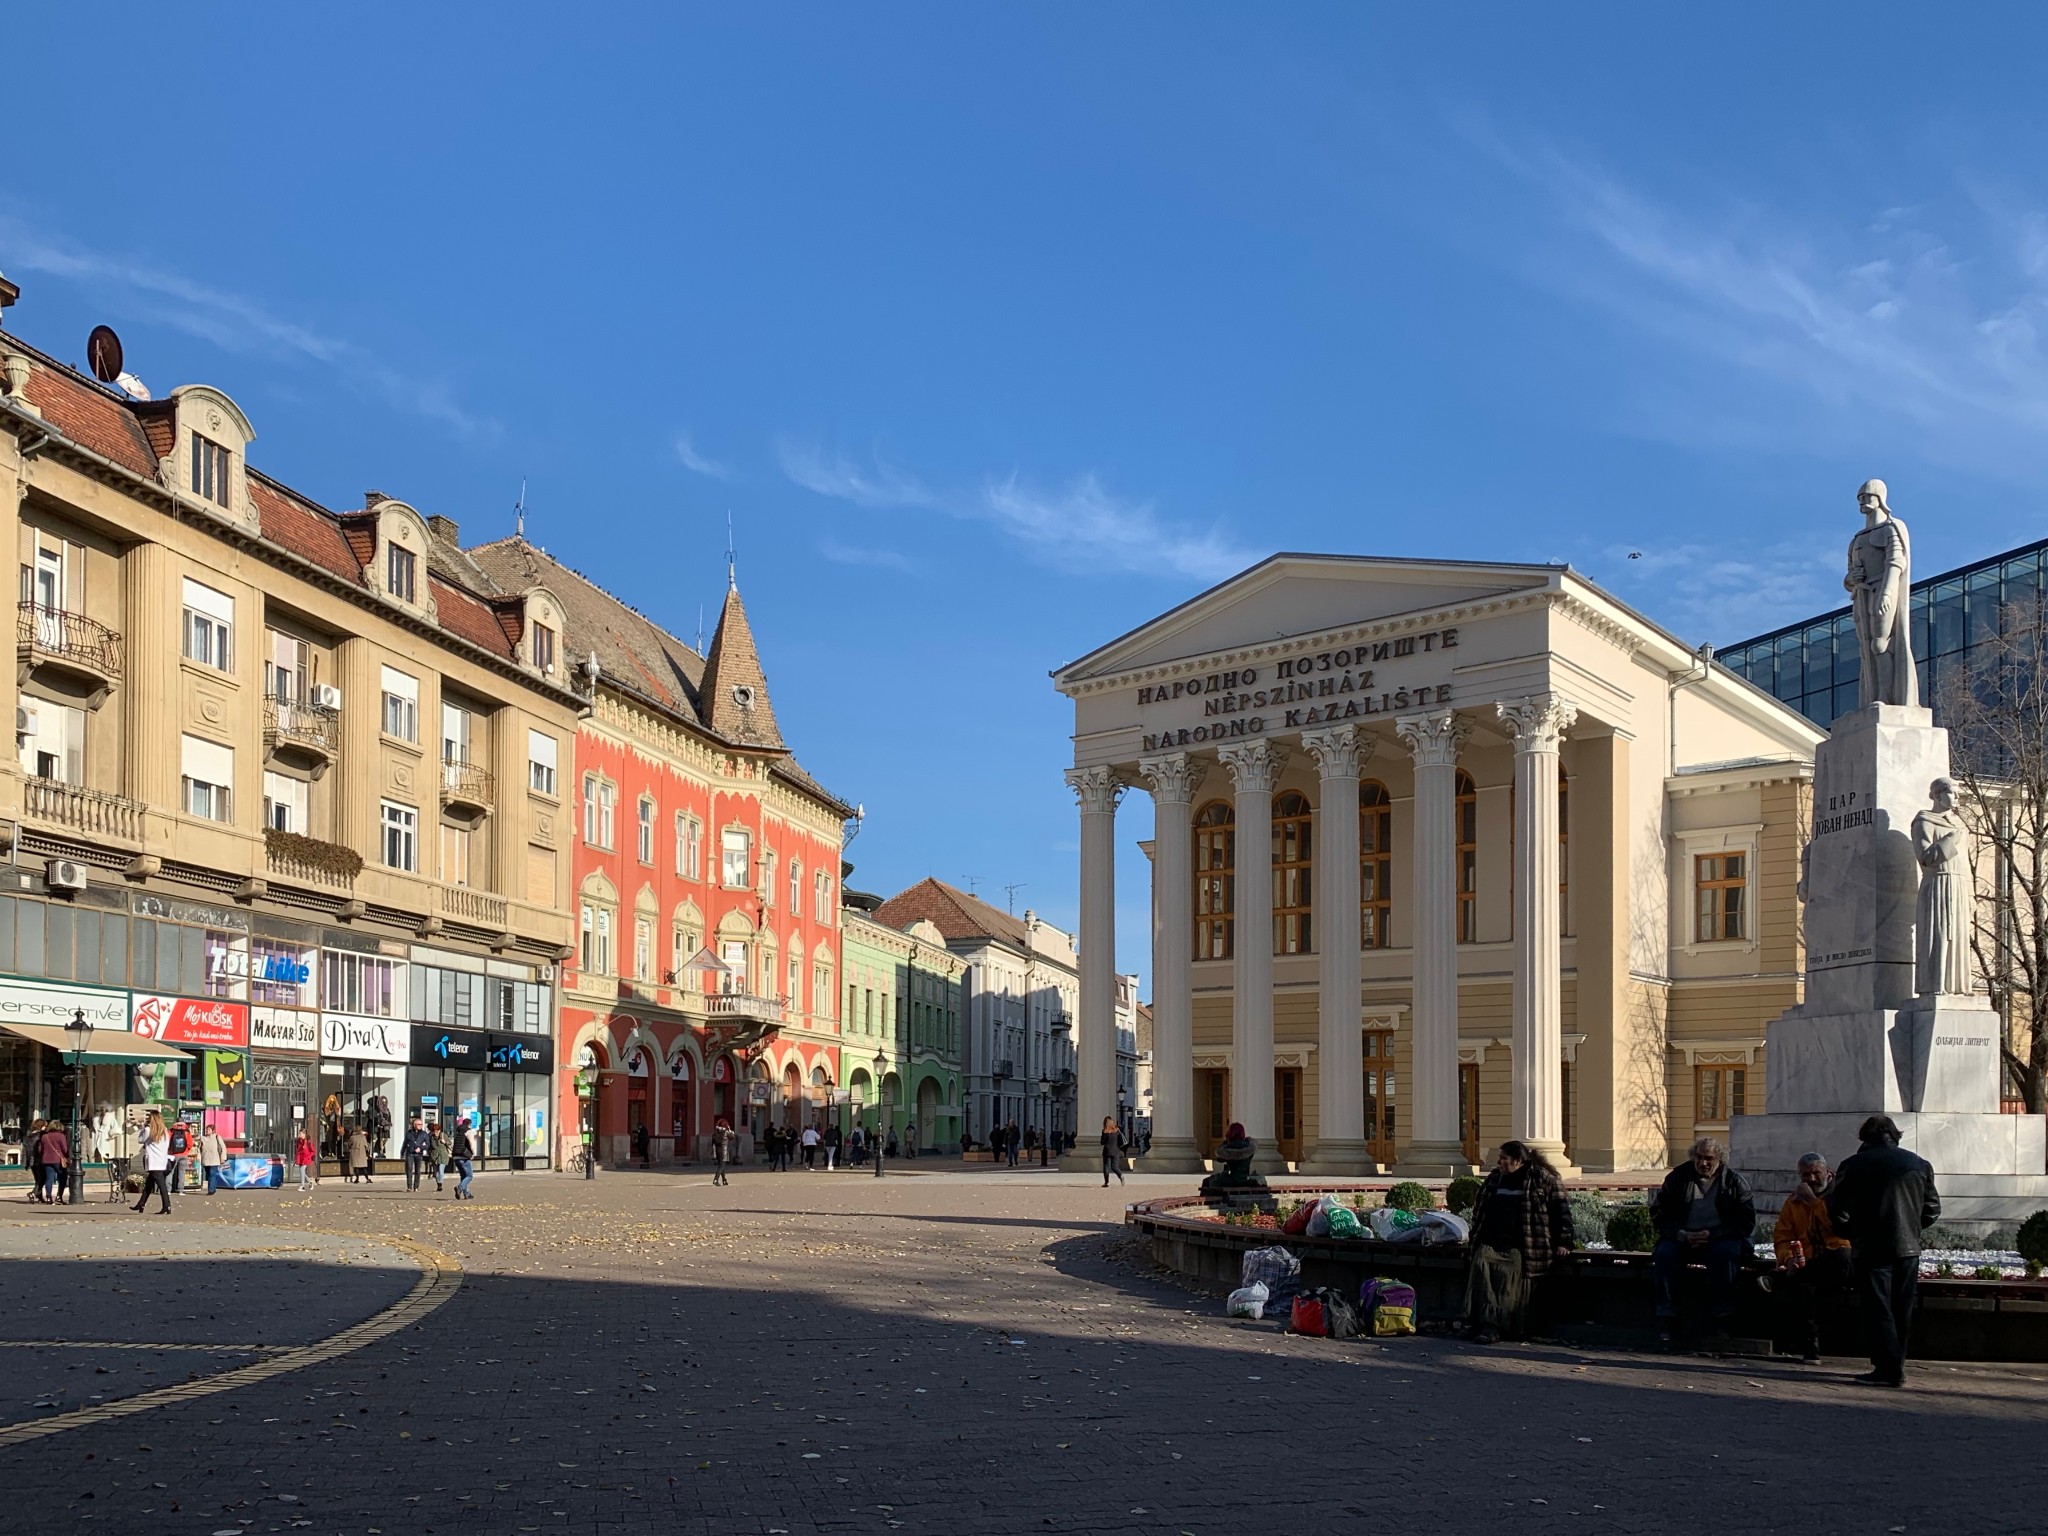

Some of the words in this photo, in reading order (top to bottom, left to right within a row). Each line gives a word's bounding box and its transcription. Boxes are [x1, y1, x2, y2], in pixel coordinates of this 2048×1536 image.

[1137, 667, 1257, 706] НАРОДНО
[1276, 628, 1458, 679] ПОЗОРИШТЕ
[1204, 669, 1375, 716] NÉPSZÍNHÁZ
[1142, 716, 1264, 752] NARODNO
[1284, 683, 1453, 728] KAZALIŠTE
[1829, 792, 1856, 811] ЦАР
[1814, 815, 1842, 841] ЈОВАН
[1843, 808, 1873, 830] НЕНАД
[448, 1041, 469, 1054] telenor
[521, 1049, 540, 1060] telenor
